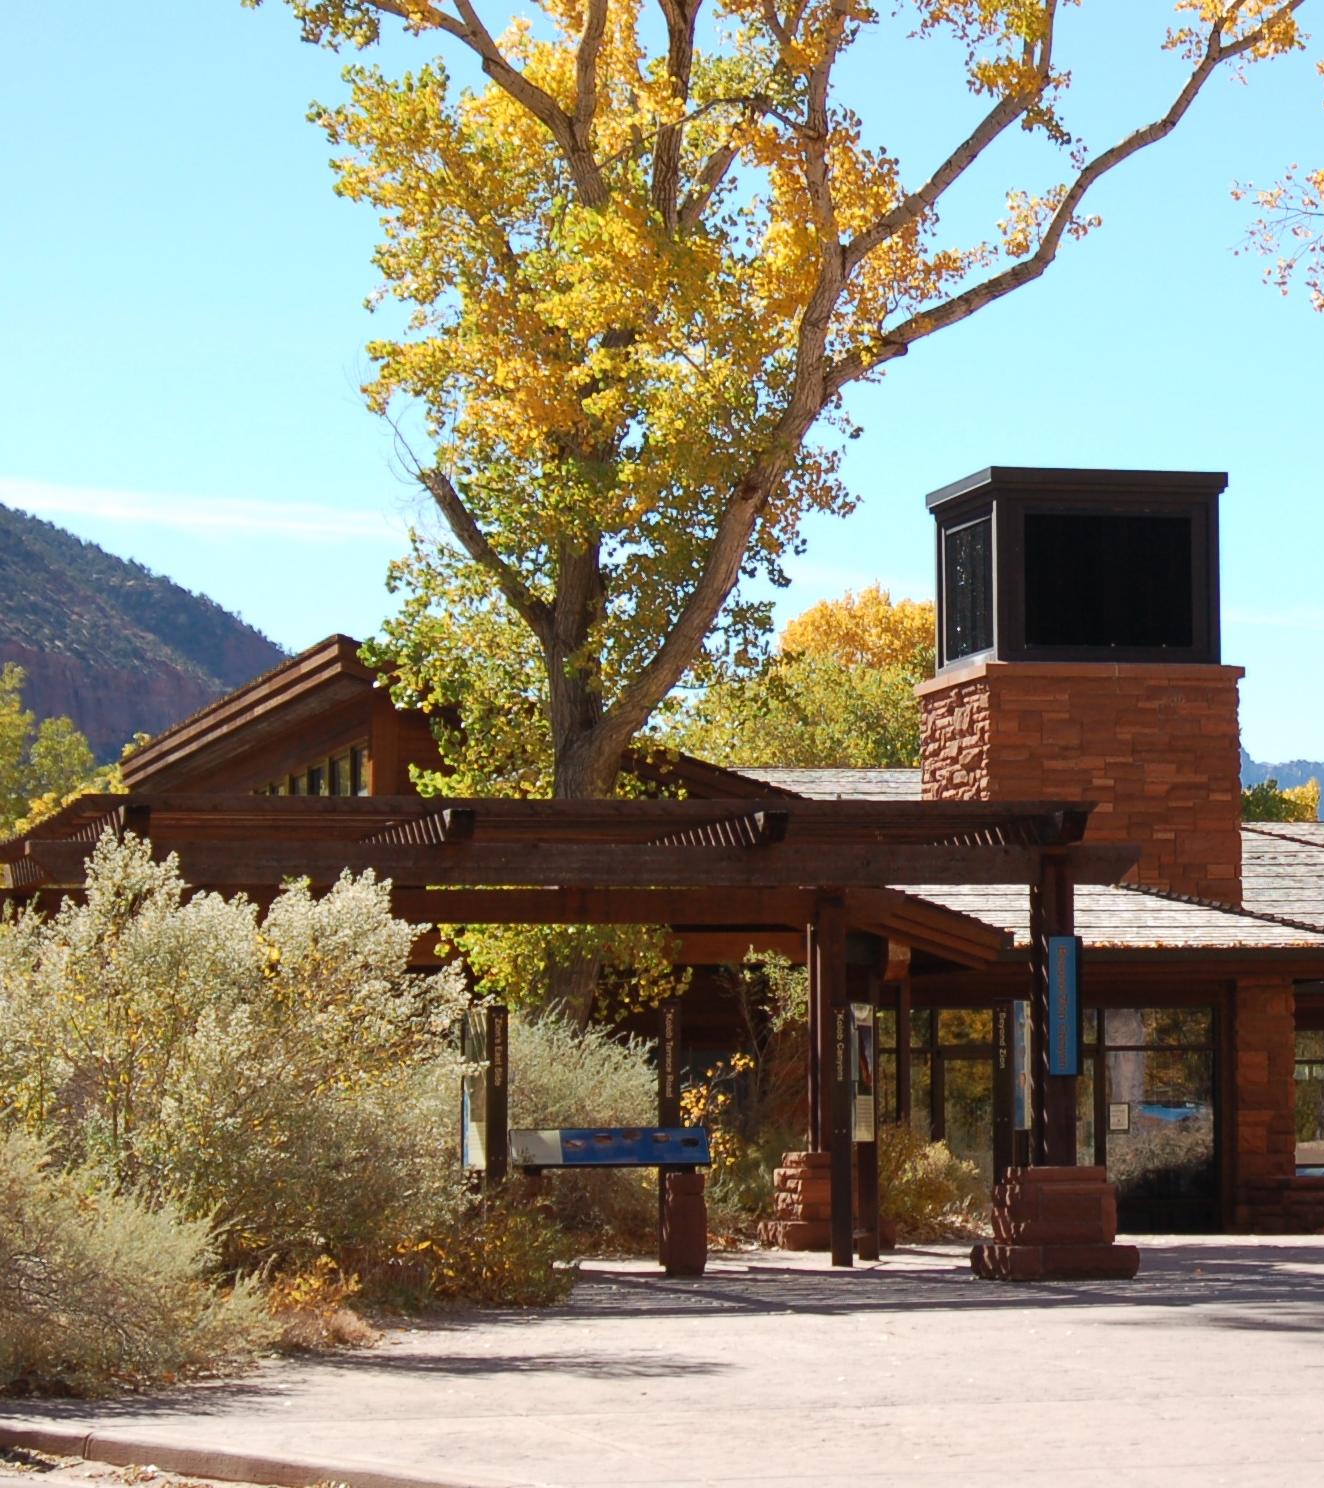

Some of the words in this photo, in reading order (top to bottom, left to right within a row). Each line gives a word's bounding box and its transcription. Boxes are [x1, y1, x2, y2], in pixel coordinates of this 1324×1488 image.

[836, 1013, 845, 1040] Kolob
[998, 1012, 1007, 1046] Beyond
[494, 1046, 503, 1065] East
[665, 1041, 674, 1072] Terrace
[835, 1042, 845, 1081] Canyons
[999, 1048, 1007, 1069] Zion
[494, 1067, 503, 1086] Side
[665, 1075, 674, 1098] Road
